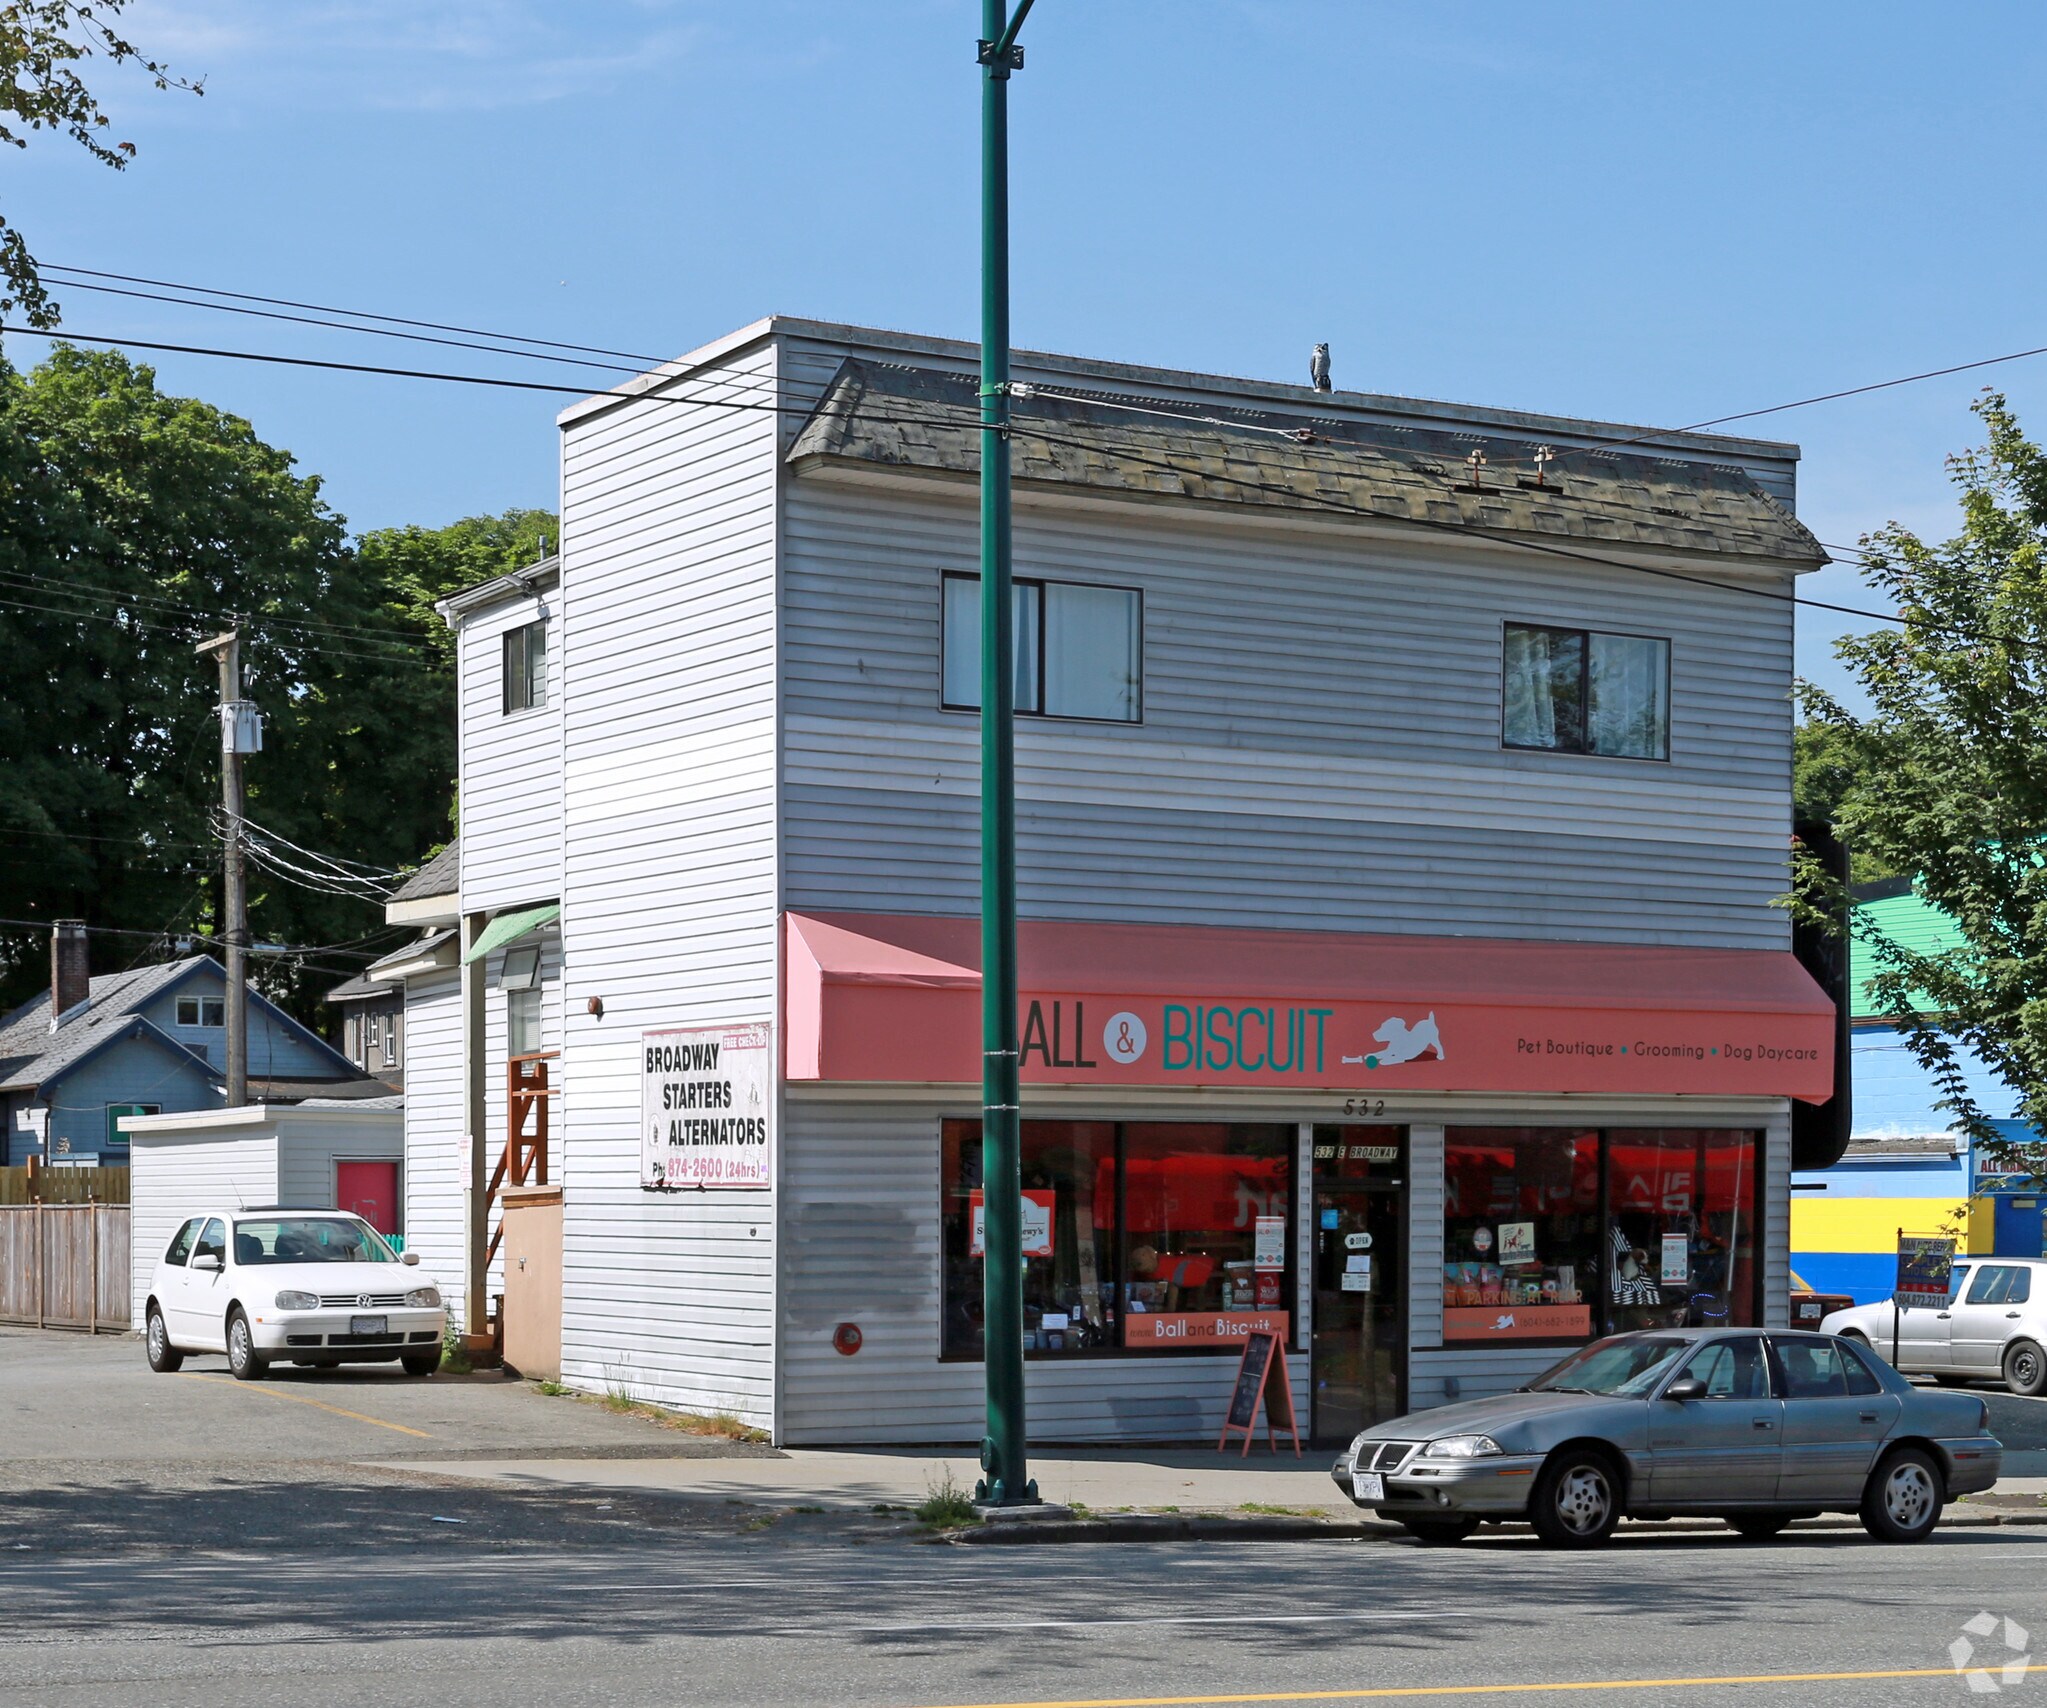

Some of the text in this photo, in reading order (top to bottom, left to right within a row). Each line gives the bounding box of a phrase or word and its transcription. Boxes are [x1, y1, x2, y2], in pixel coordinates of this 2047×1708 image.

[723, 1036, 737, 1049] FREE
[1018, 1000, 1334, 1073] ALL & BISCUIT
[646, 1043, 719, 1073] BROADWAY
[1517, 1038, 1818, 1061] Pet Boutique Grooming Dog Daycare
[663, 1081, 731, 1110] STARTERS
[1343, 1099, 1385, 1116] 532
[669, 1117, 765, 1146] ALTERNATORS
[1314, 1147, 1398, 1159] 532 E BROADWAY
[668, 1157, 722, 1178] 874-2600
[725, 1160, 760, 1179] (24hrs)
[1981, 1159, 1998, 1173] ALL
[1467, 1289, 1583, 1305] PARKING AT REAR
